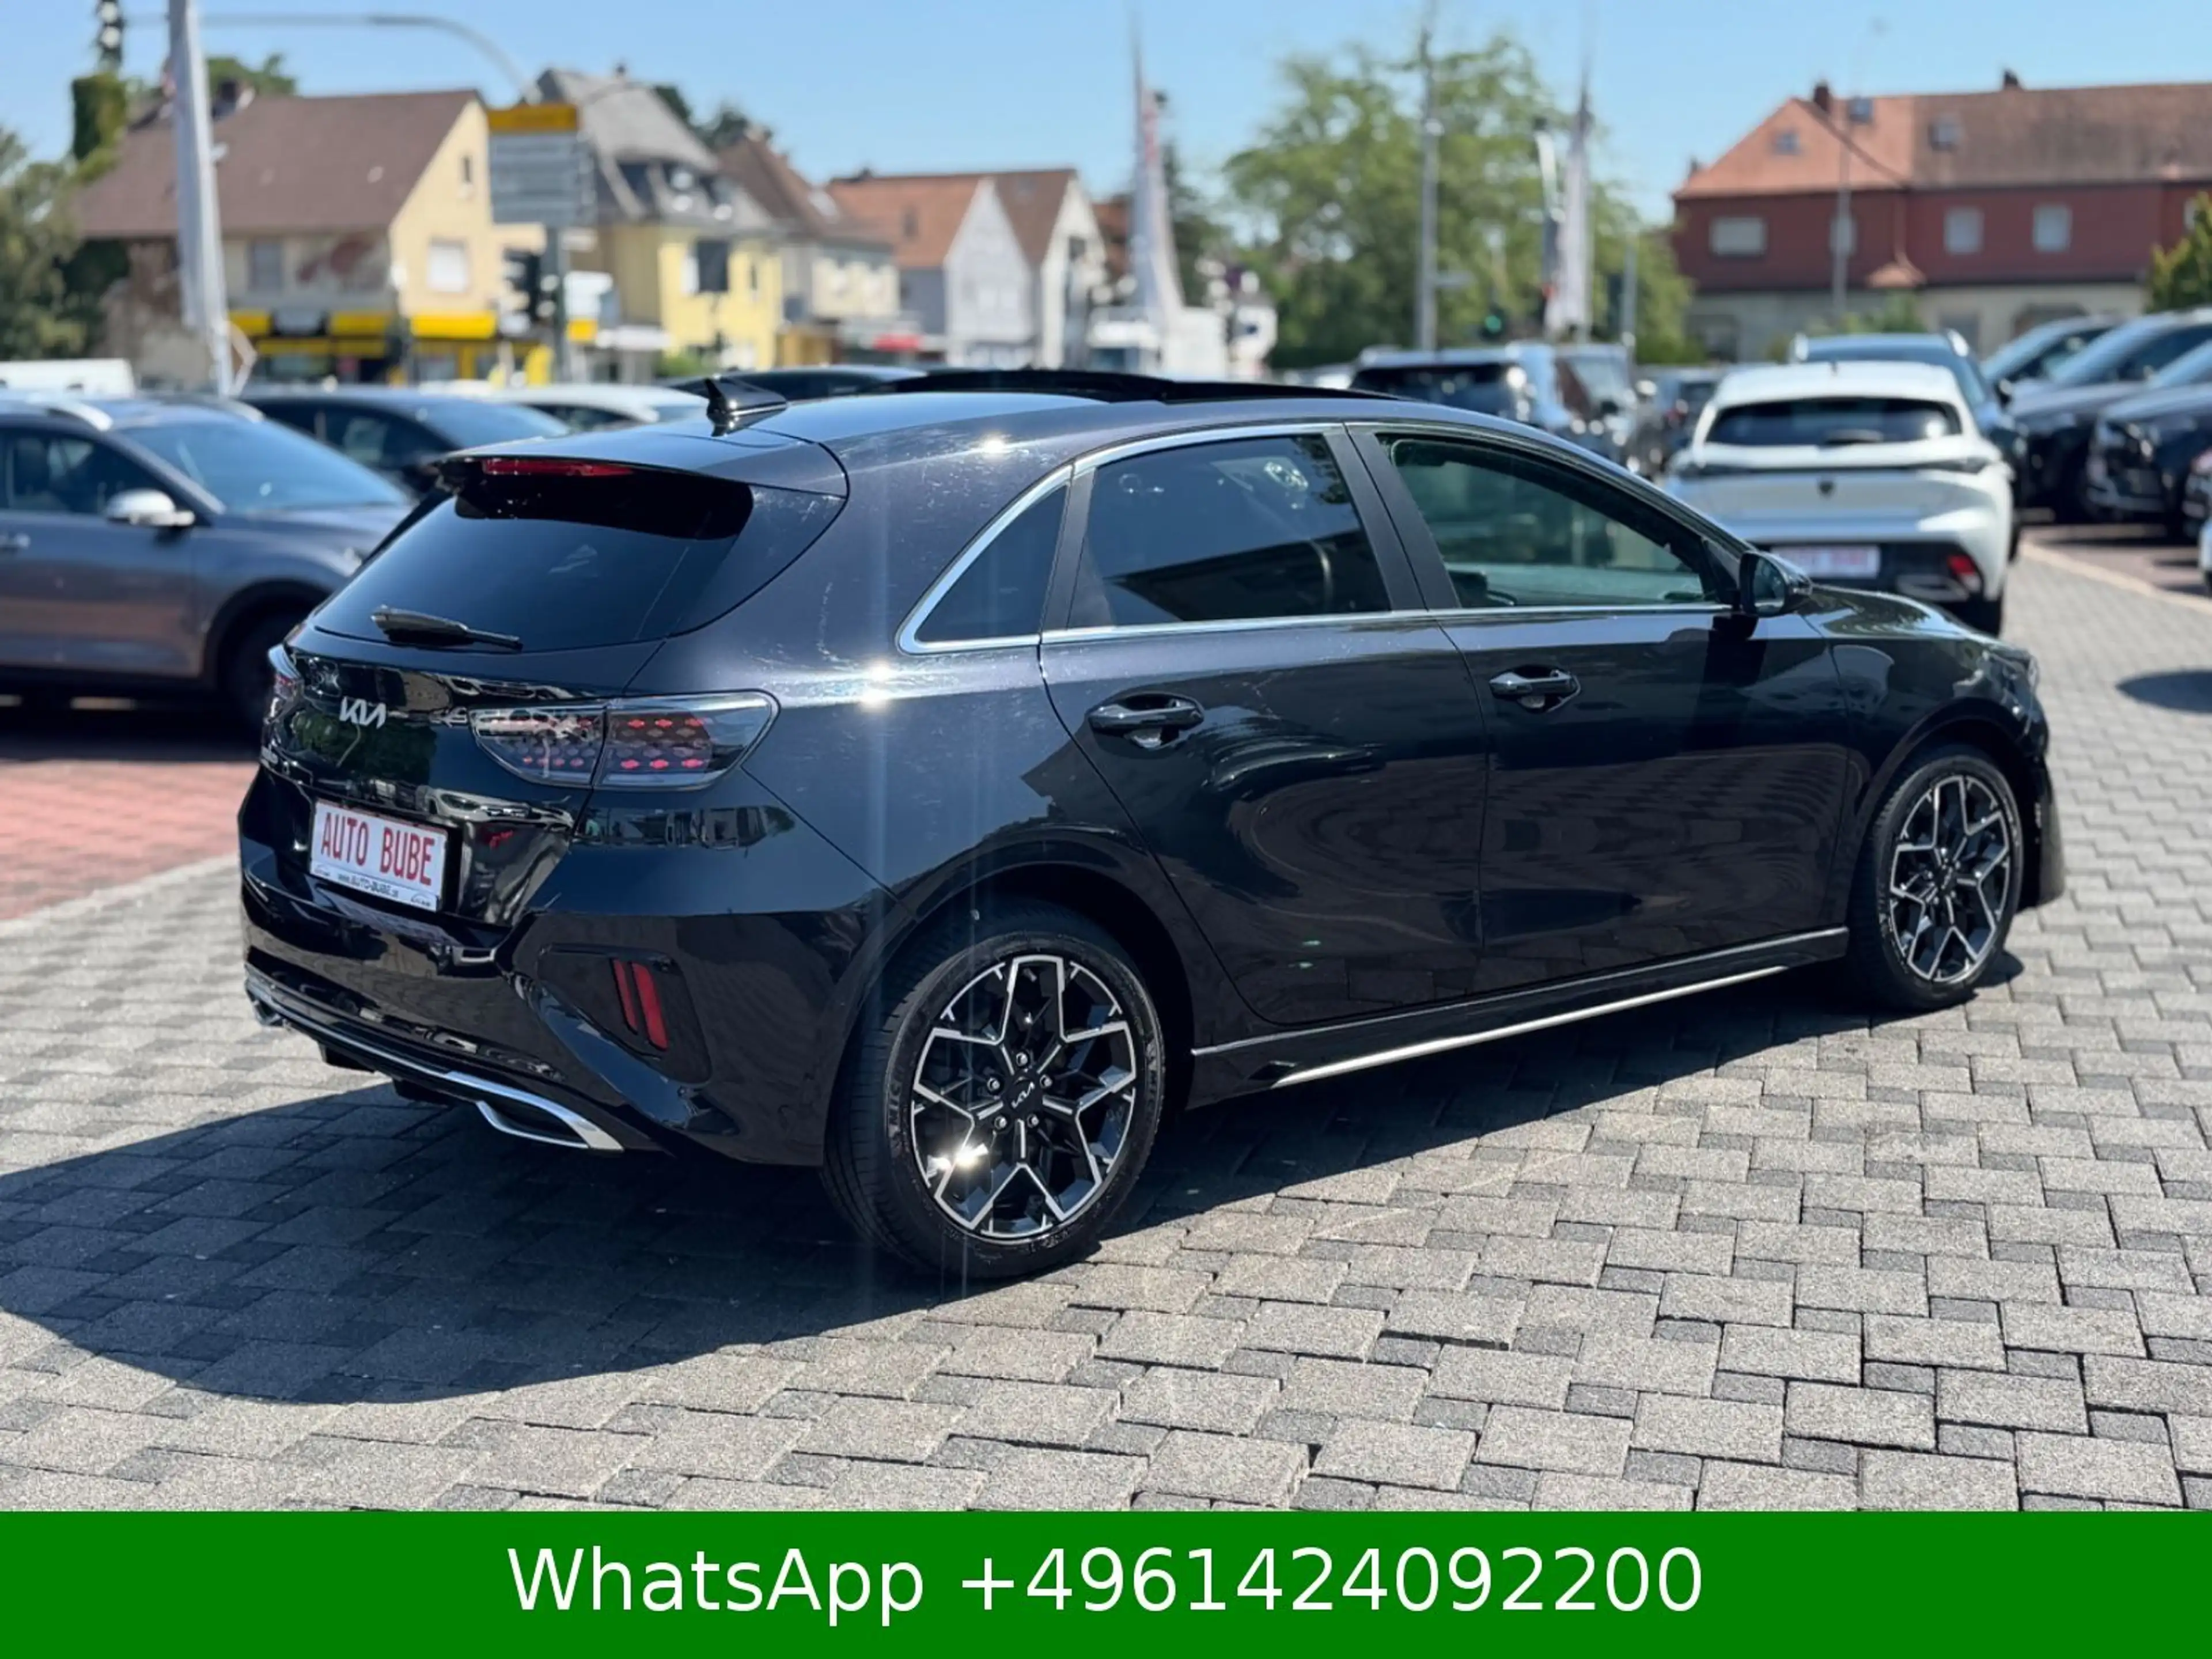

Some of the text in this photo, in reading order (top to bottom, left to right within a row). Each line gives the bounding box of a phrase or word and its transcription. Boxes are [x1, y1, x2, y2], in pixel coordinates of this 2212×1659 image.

[339, 696, 387, 729] KIA
[321, 812, 435, 886] AUTO BUBE
